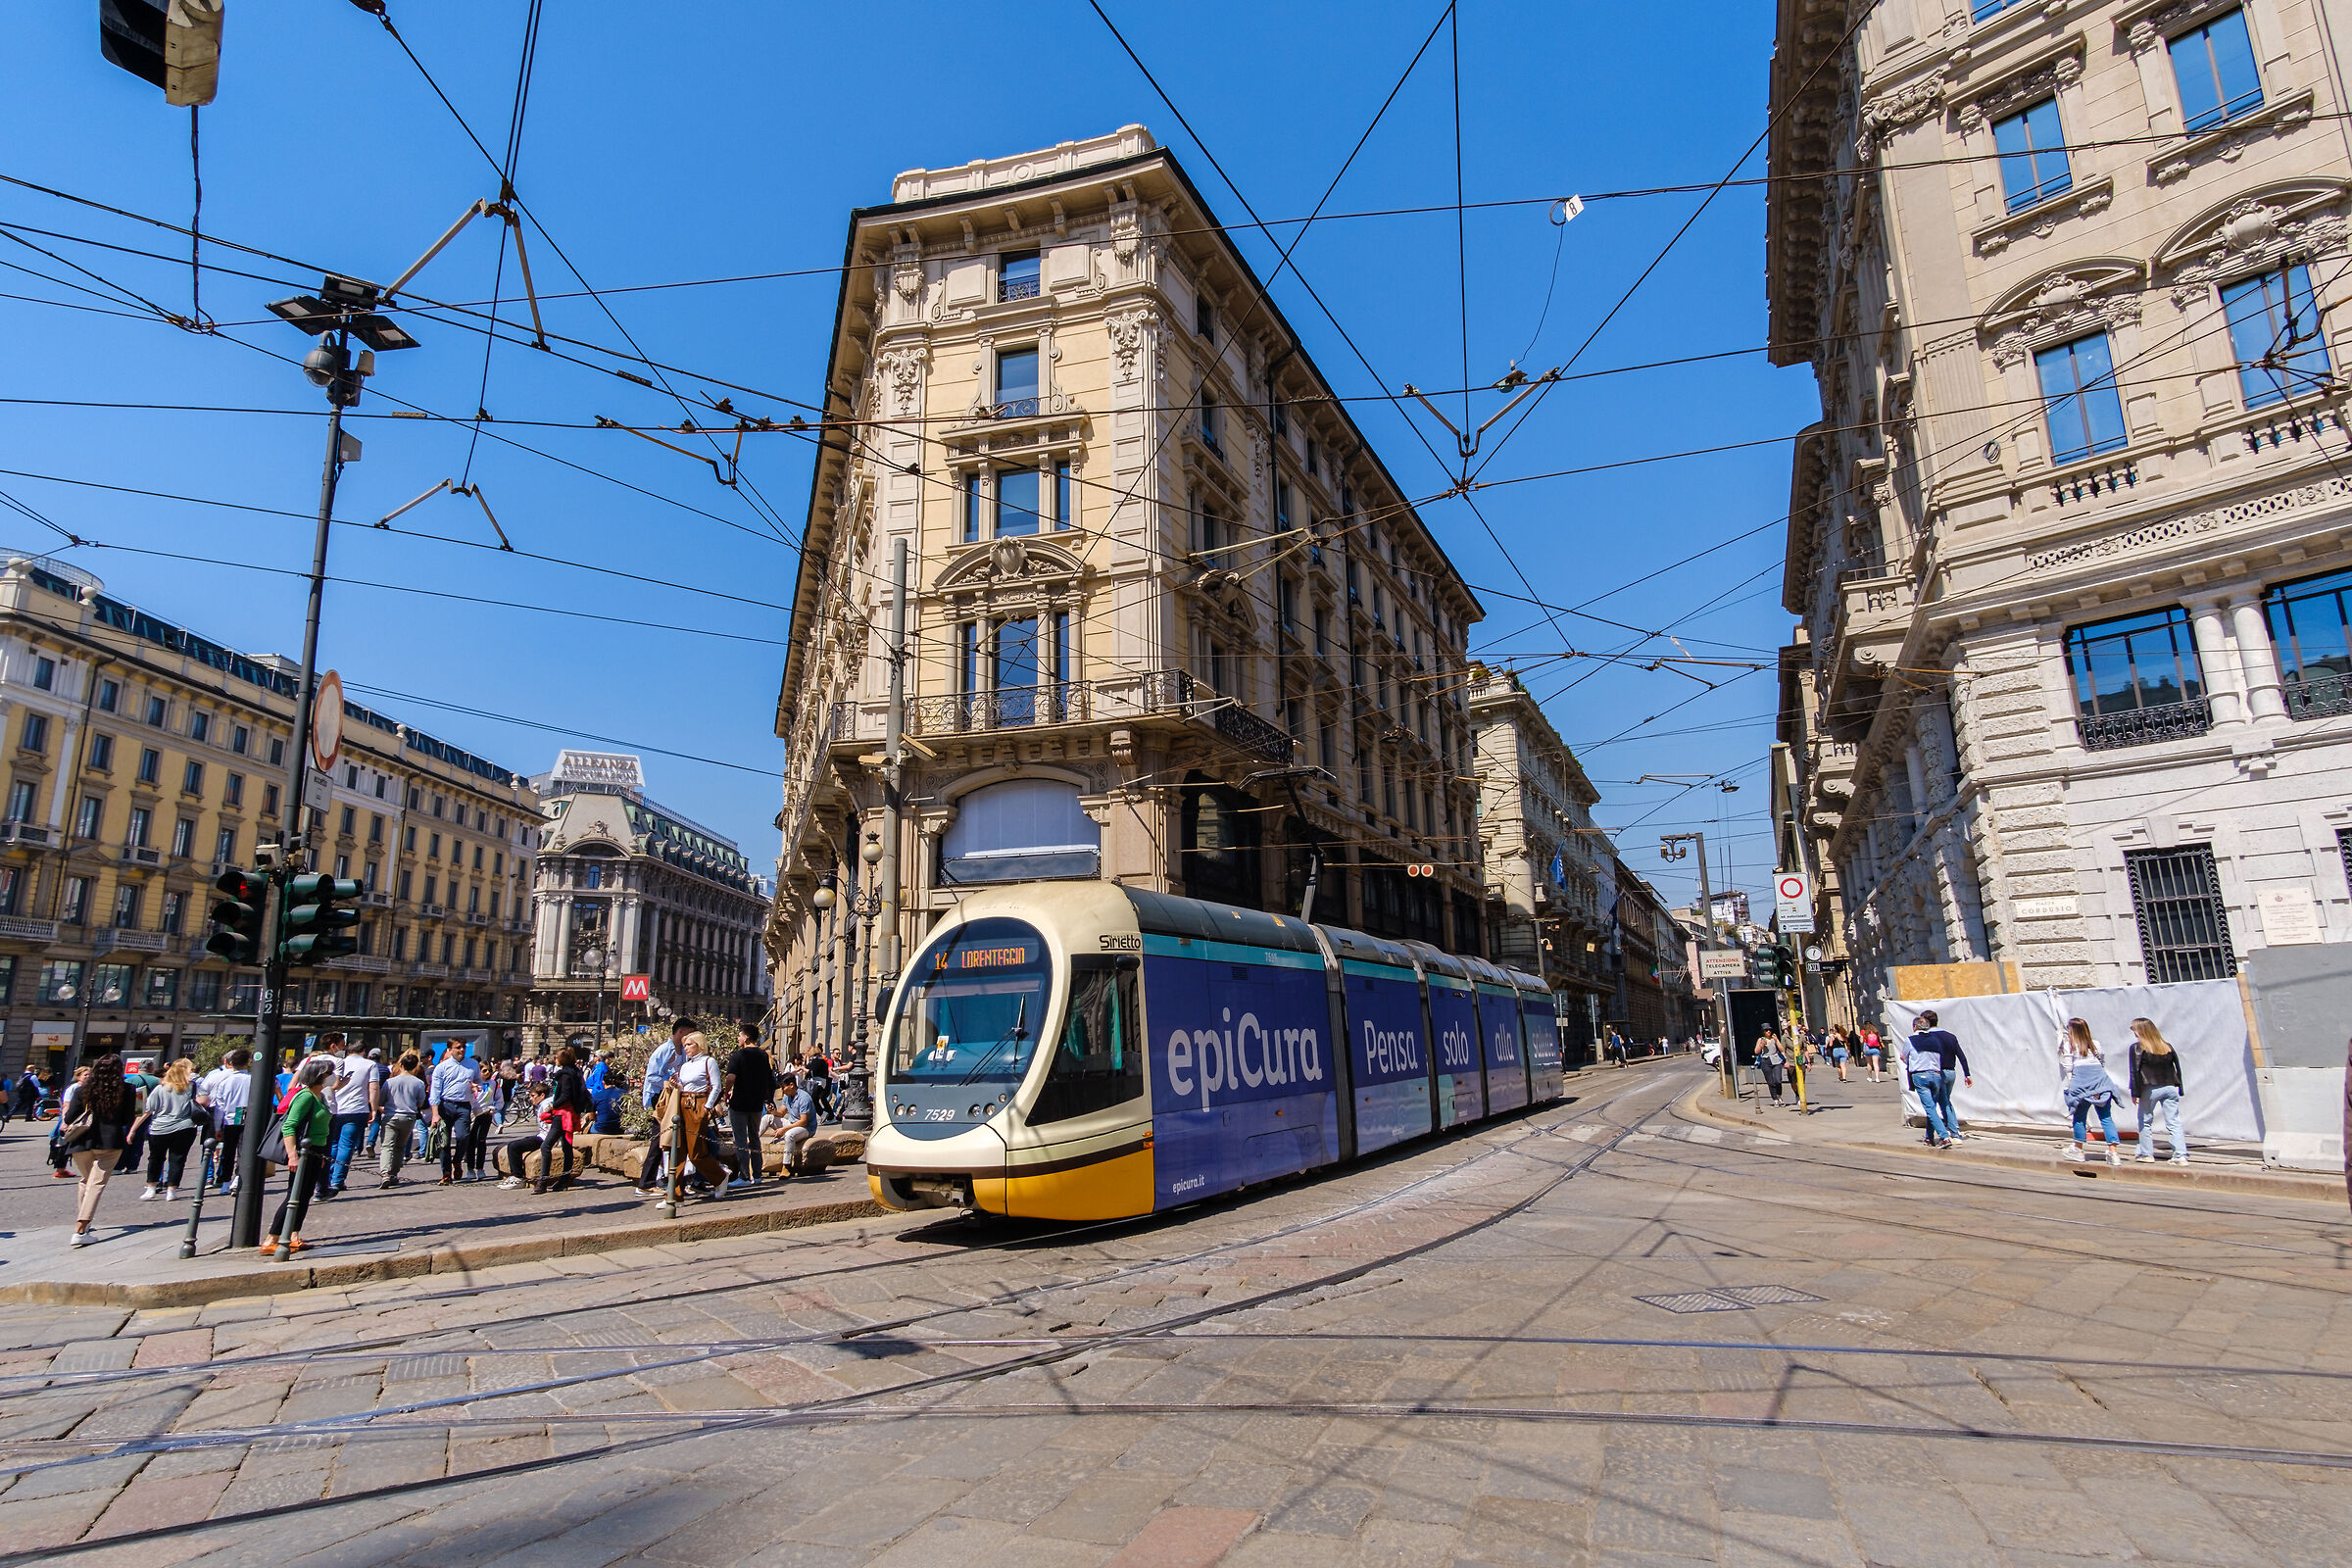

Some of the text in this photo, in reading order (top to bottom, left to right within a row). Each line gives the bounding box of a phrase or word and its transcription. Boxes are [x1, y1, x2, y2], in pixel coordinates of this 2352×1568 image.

[1569, 202, 1578, 216] 8
[2021, 906, 2073, 915] CORDUSIO
[934, 947, 1025, 970] 14 LORENTEGGIO
[624, 980, 647, 996] M
[1363, 1019, 1418, 1075] Pensa
[1443, 1020, 1469, 1066] solo
[1494, 1022, 1515, 1062] alla
[1167, 1006, 1323, 1112] epiCura
[924, 1108, 956, 1121] 7529
[1172, 1174, 1205, 1196] epicura.it
